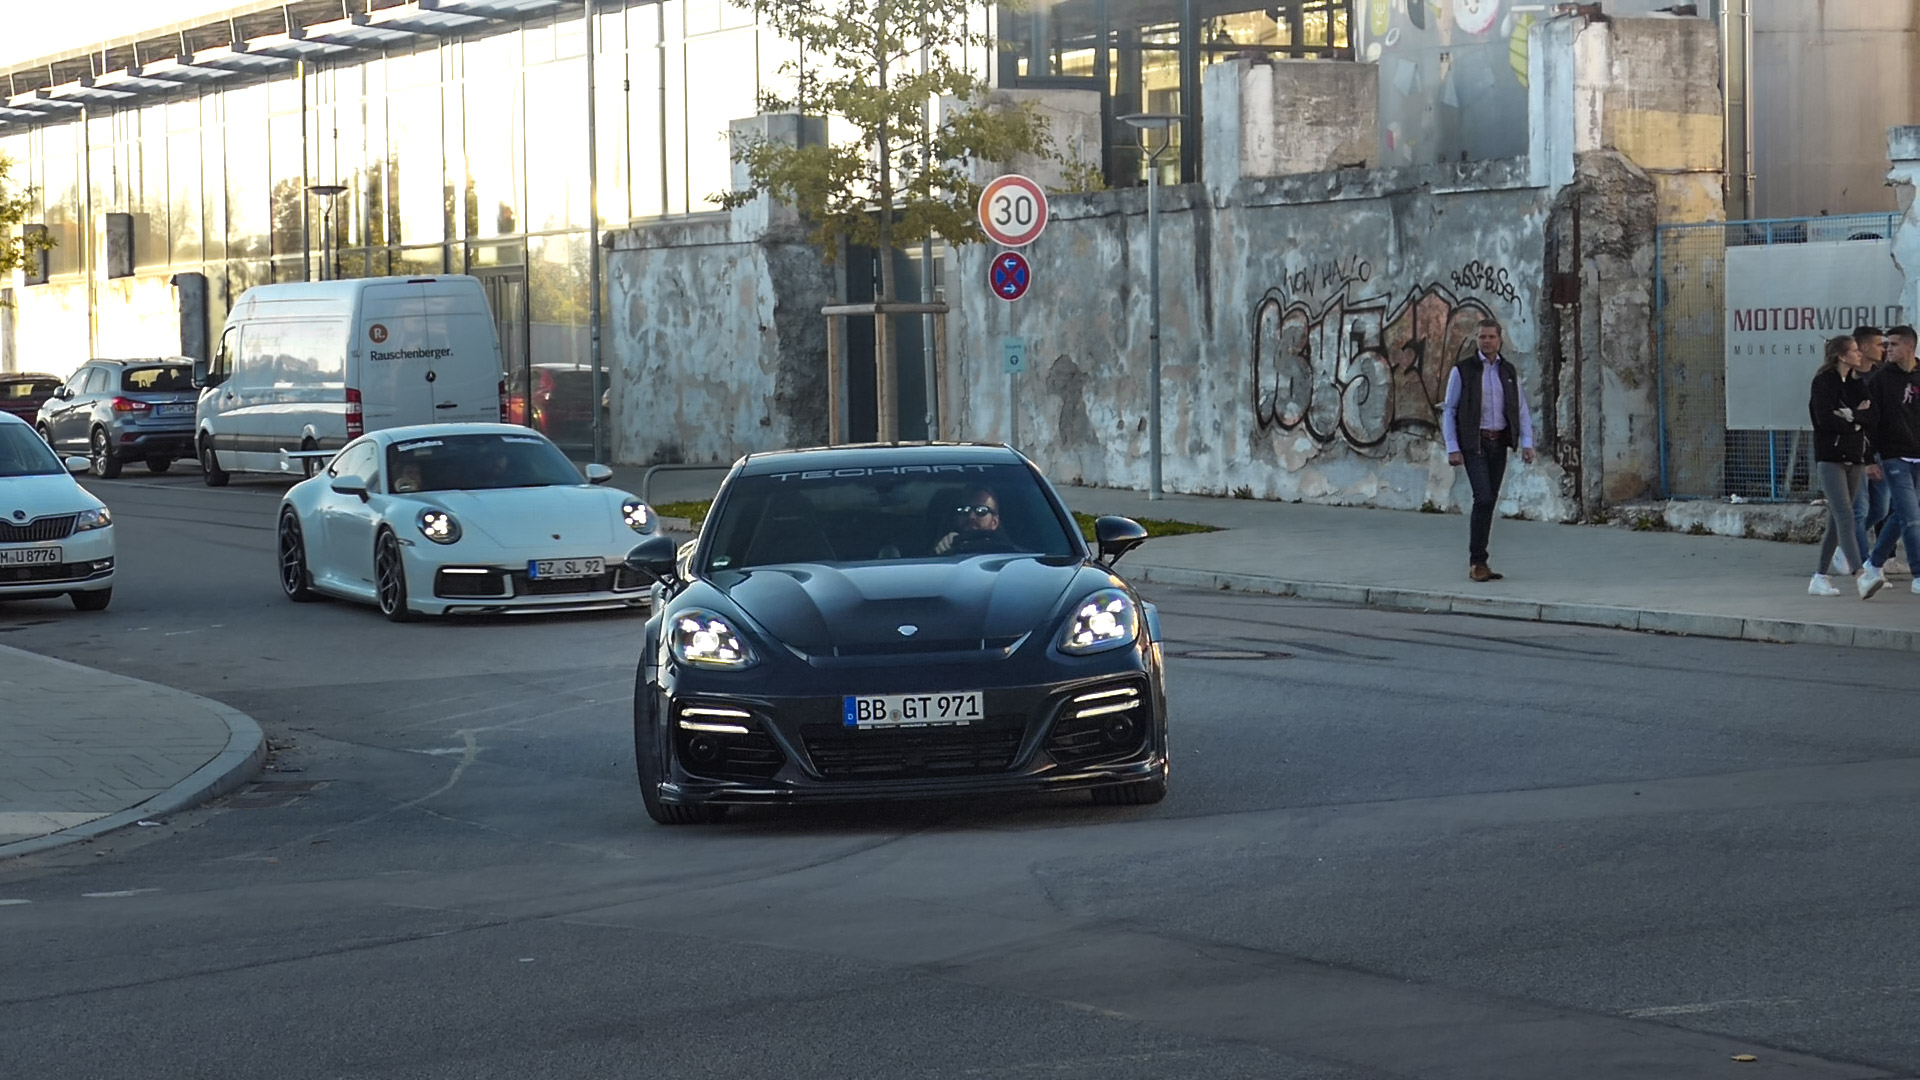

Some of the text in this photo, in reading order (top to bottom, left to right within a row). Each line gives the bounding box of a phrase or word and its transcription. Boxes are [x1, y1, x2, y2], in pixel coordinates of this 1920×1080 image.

[995, 195, 1032, 225] 30
[1321, 254, 1372, 289] HALLO
[1733, 305, 1904, 331] MOTORWORLD
[370, 348, 454, 361] Rauschenberger.
[1733, 343, 1816, 355] MÜNCHEN
[770, 464, 994, 482] TECHART
[0, 549, 56, 563] M U 8776
[538, 560, 600, 575] GZ SL 92
[857, 699, 887, 721] BB
[903, 697, 932, 719] GT
[937, 695, 979, 718] 971
